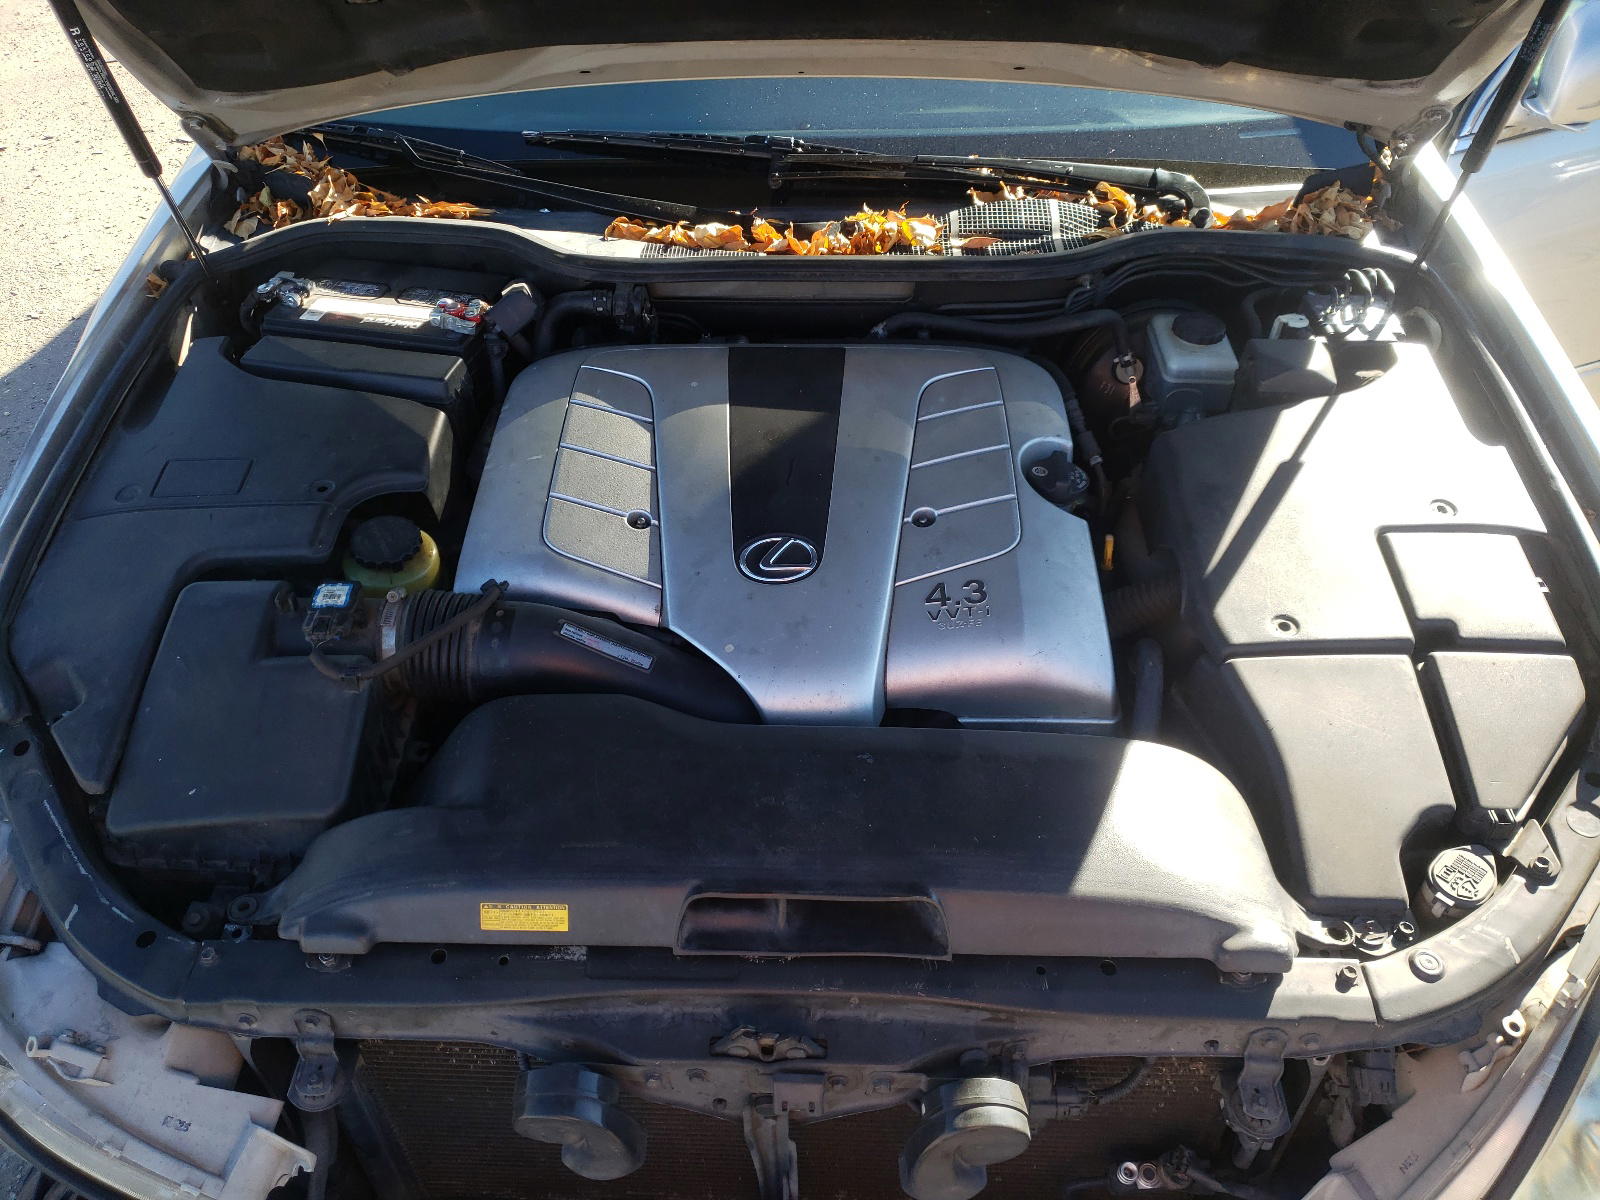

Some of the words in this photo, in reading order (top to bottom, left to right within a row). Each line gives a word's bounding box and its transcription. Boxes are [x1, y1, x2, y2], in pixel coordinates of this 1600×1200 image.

[70, 27, 80, 36] R
[925, 579, 988, 608] 4.3
[926, 605, 990, 622] VVT-i
